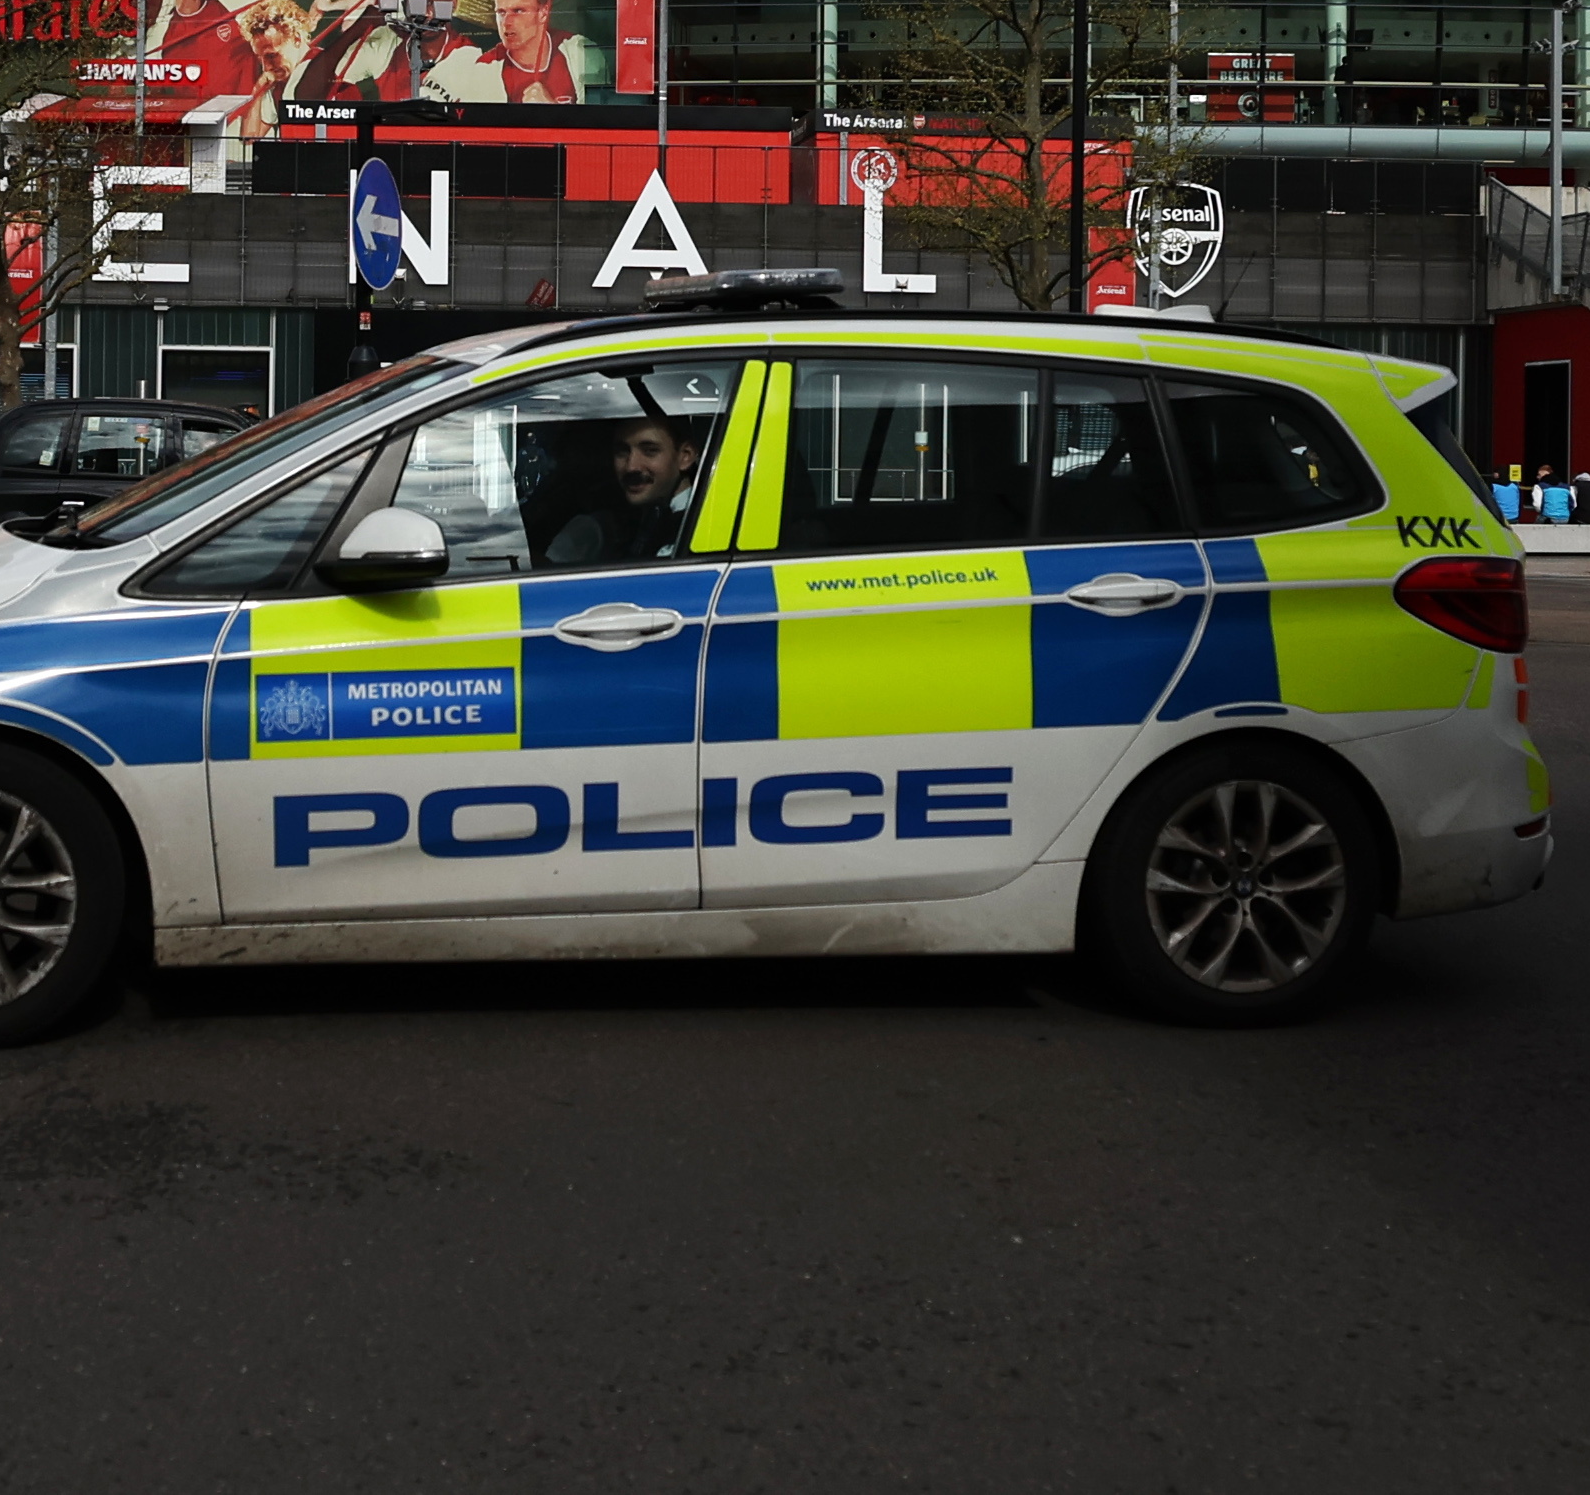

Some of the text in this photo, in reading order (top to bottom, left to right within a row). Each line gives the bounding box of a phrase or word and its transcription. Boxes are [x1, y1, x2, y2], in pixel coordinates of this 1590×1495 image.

[285, 104, 314, 119] The
[823, 113, 850, 128] The
[1140, 205, 1211, 223] Asenal
[1395, 515, 1483, 549] KXK
[806, 565, 999, 594] www.met.police.uk
[347, 677, 503, 701] METROPOLITAN
[370, 704, 483, 728] POLICE
[273, 766, 1014, 868] POLICE
